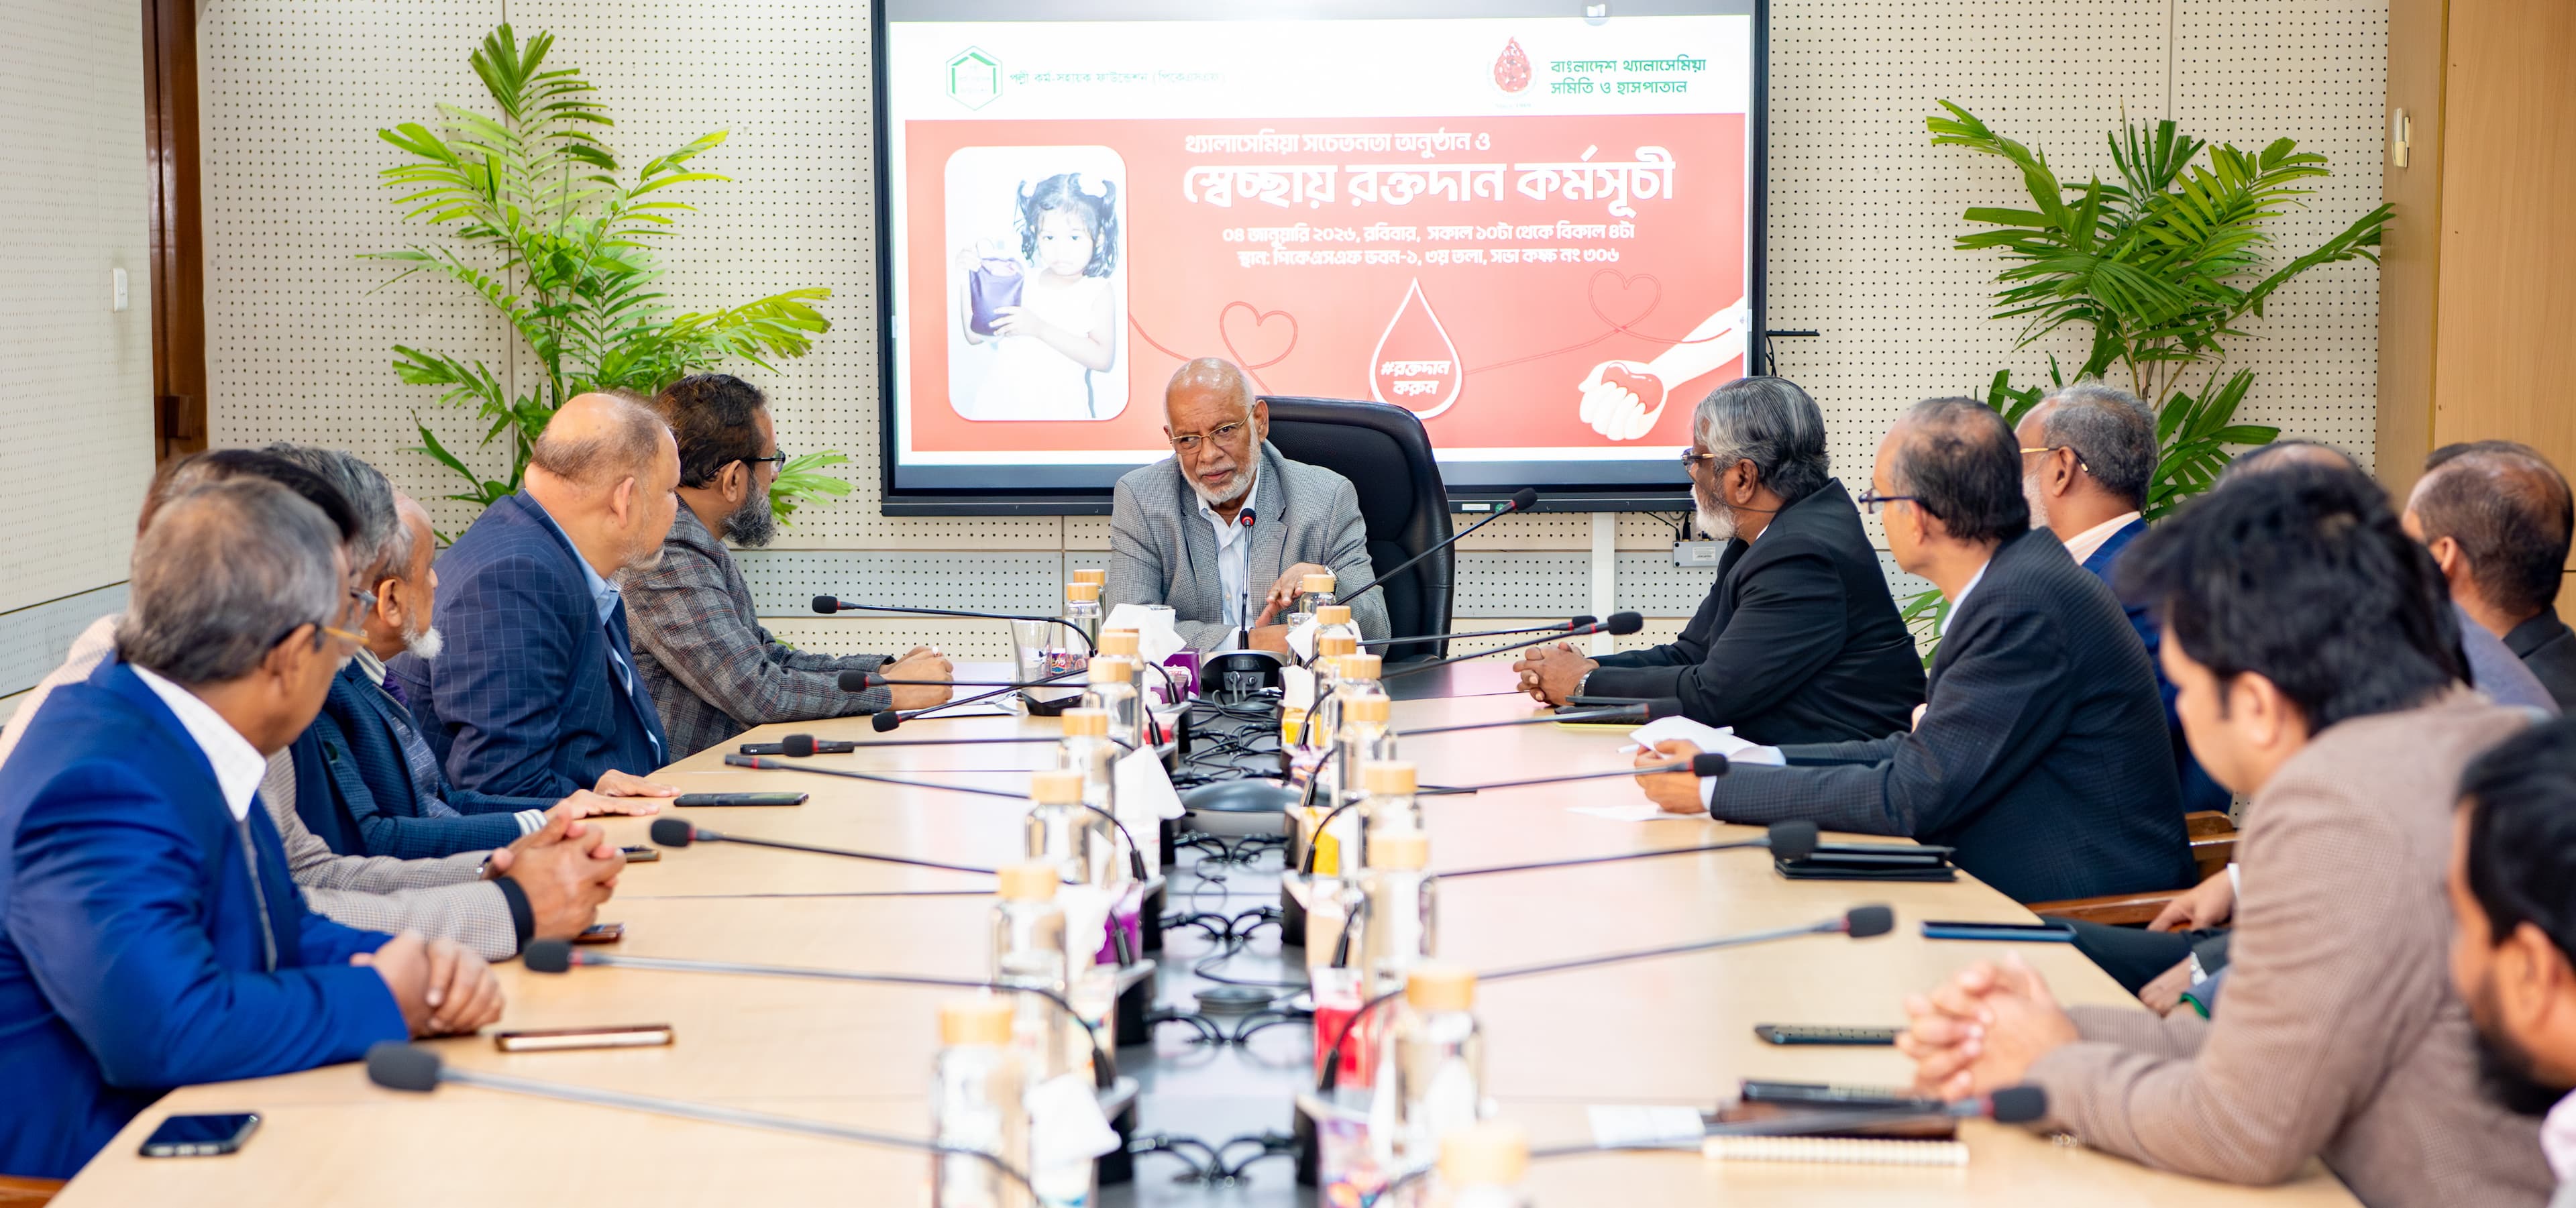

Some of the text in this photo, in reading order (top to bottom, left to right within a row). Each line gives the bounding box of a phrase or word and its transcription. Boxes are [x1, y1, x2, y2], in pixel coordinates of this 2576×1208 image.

[1550, 54, 1707, 74] বাংলাদেশ থ্যালাসেমিয়া
[1550, 76, 1688, 95] সমিতি ও হাসপাতাল
[1185, 127, 1491, 158] থ্যালাসেমিয়া সচেতনতা অনুষ্ঠান ও
[1183, 145, 1676, 218] স্বেচ্ছায় রক্তদান কর্মসূচী
[1223, 220, 1635, 248] ০৪ জানুয়ারি ২০২৬, রবিবার, সকাল ১০টা থেকে বিকাল ৪টা
[1237, 246, 1619, 268] স্থান: পিকেএসএফ ভবন-১, ৩য় তলা, সভা কক্ষ নং ৩০৬
[1381, 360, 1451, 377] #রক্তদান
[1393, 380, 1439, 396] করুন
